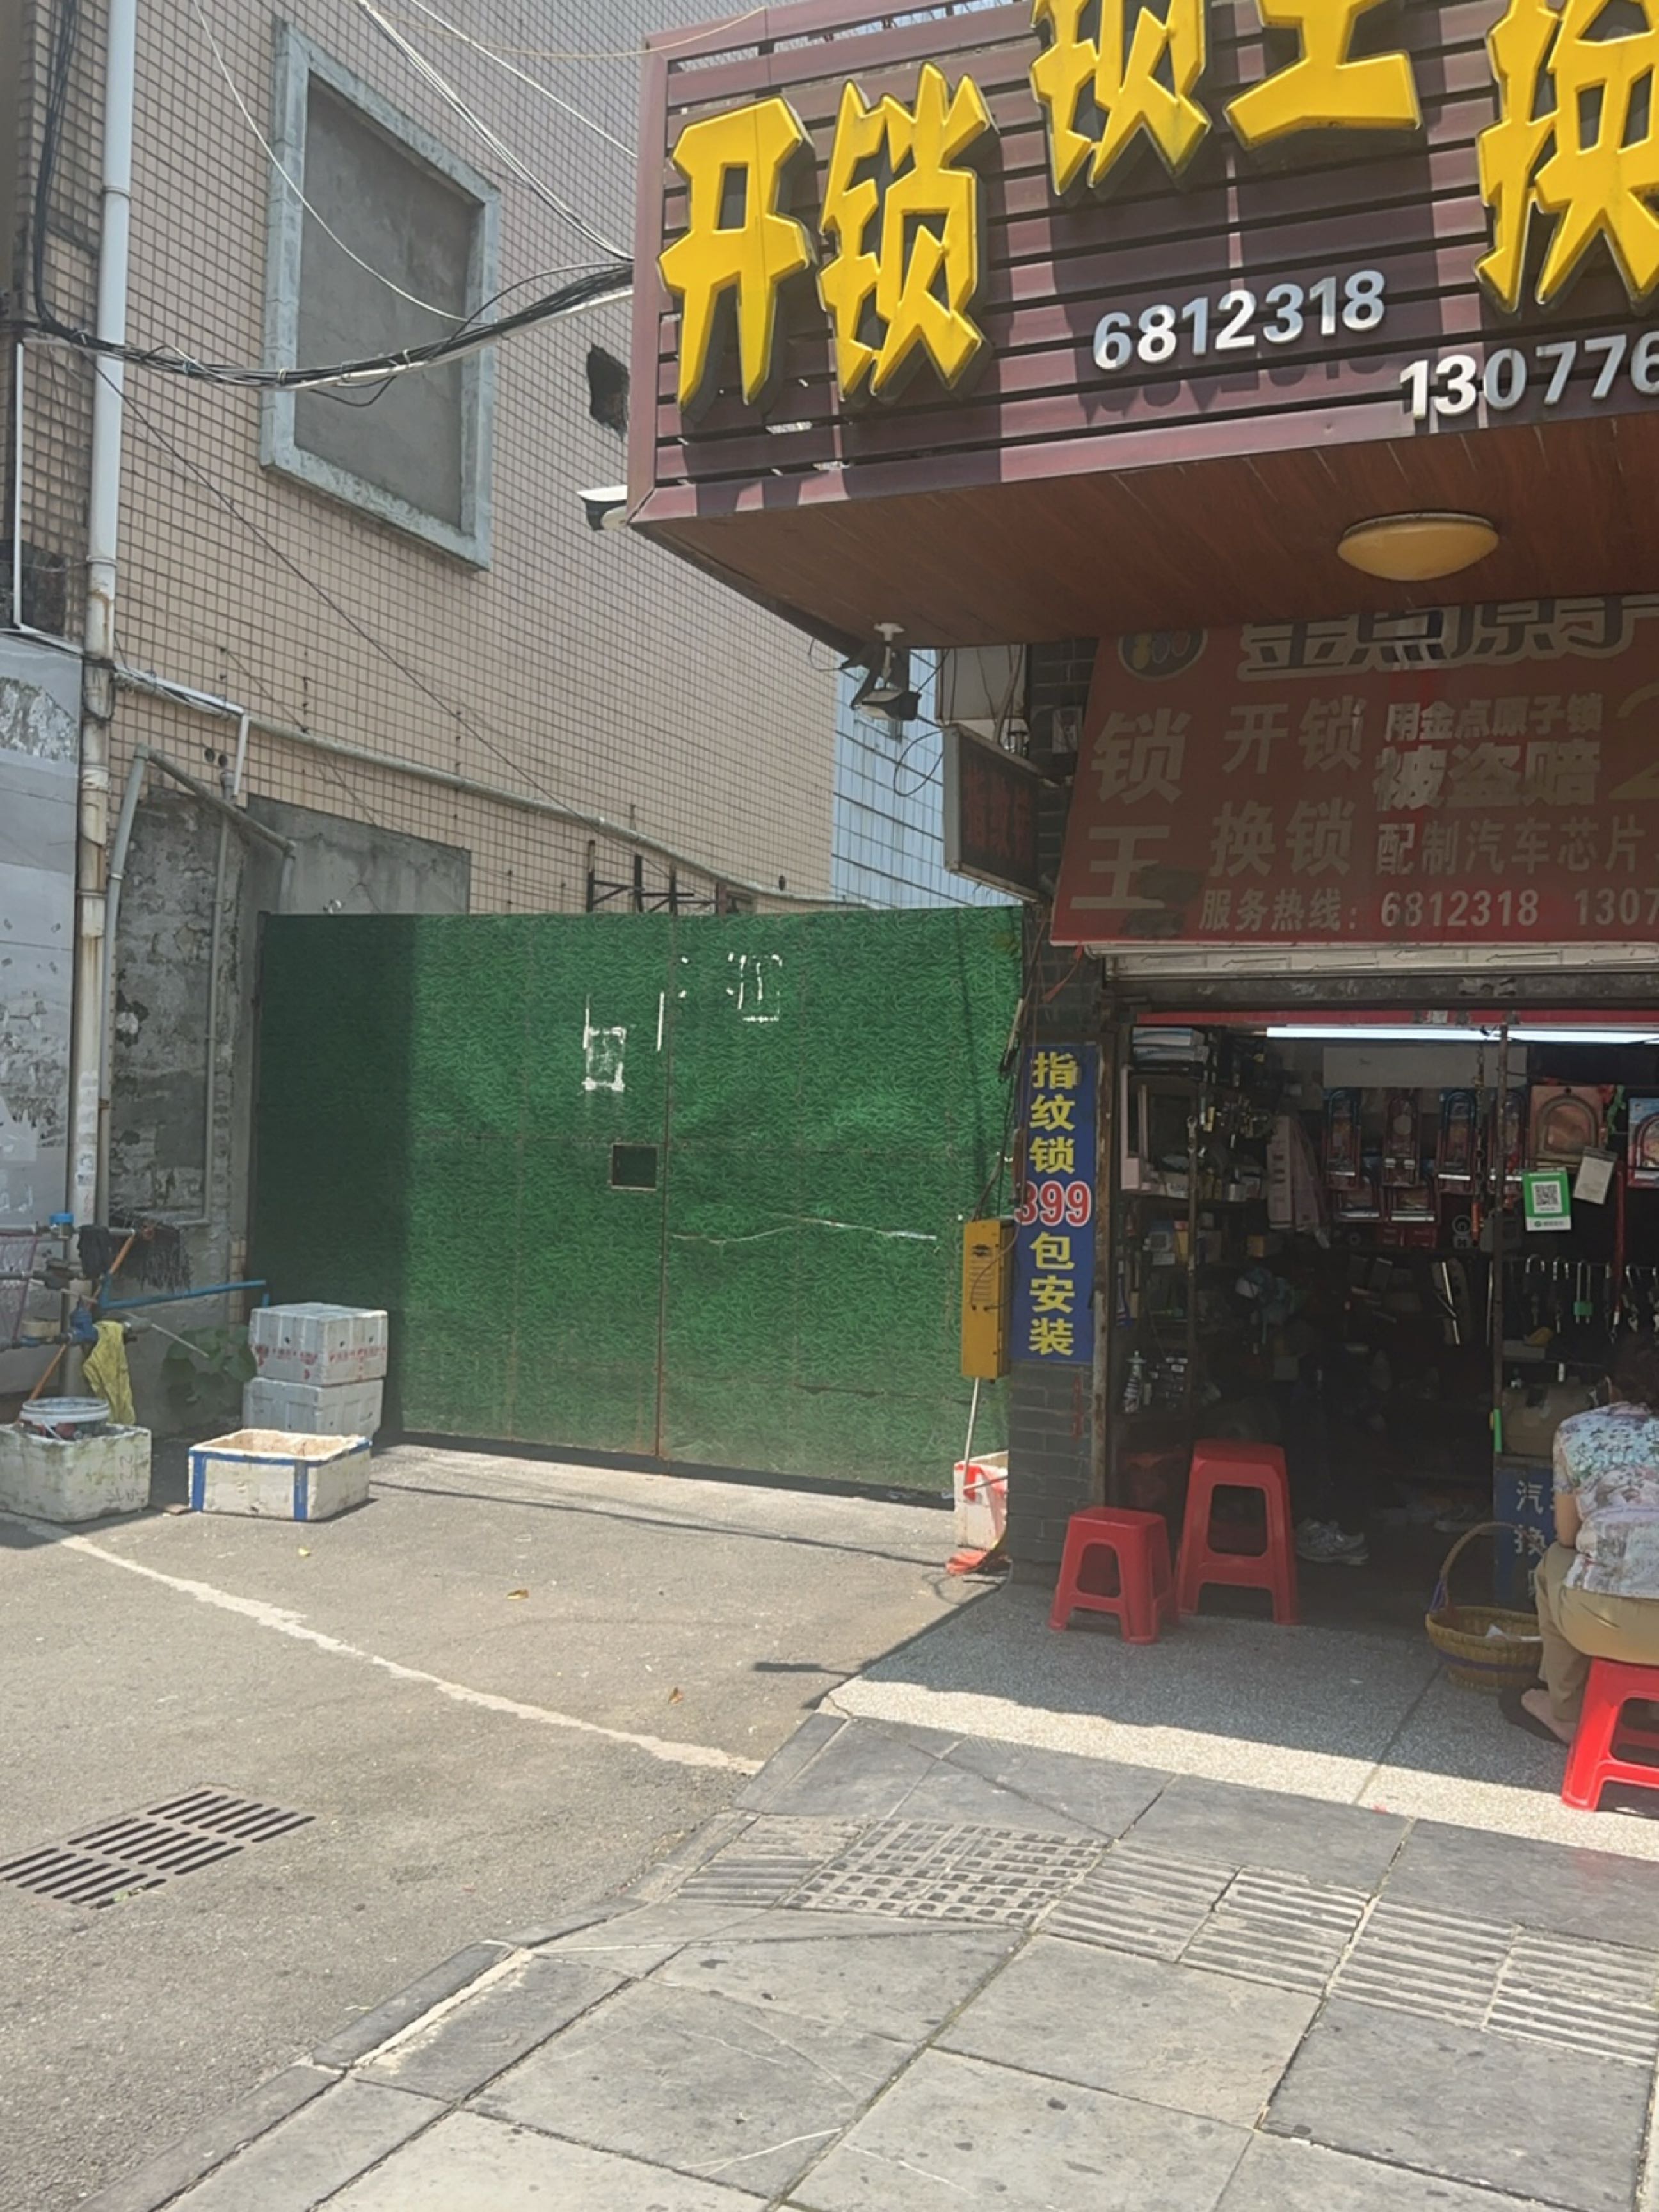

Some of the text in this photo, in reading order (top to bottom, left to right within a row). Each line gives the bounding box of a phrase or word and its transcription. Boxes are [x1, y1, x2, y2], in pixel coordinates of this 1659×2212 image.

[658, 63, 993, 406] 开锁
[1093, 269, 1386, 371] 6812318
[1399, 331, 1659, 420] 130776
[1222, 694, 1368, 774] 开锁
[1384, 691, 1603, 742] 用金点原子锁
[1372, 737, 1601, 812] 被盗赔
[1208, 798, 1356, 877] 换锁
[1375, 813, 1659, 876] 配制汽车芯片
[1381, 890, 1538, 927] 6812318
[1029, 1051, 1079, 1175] 指纹锁
[1014, 1180, 1091, 1226] 399
[1028, 1231, 1076, 1356] 包安装
